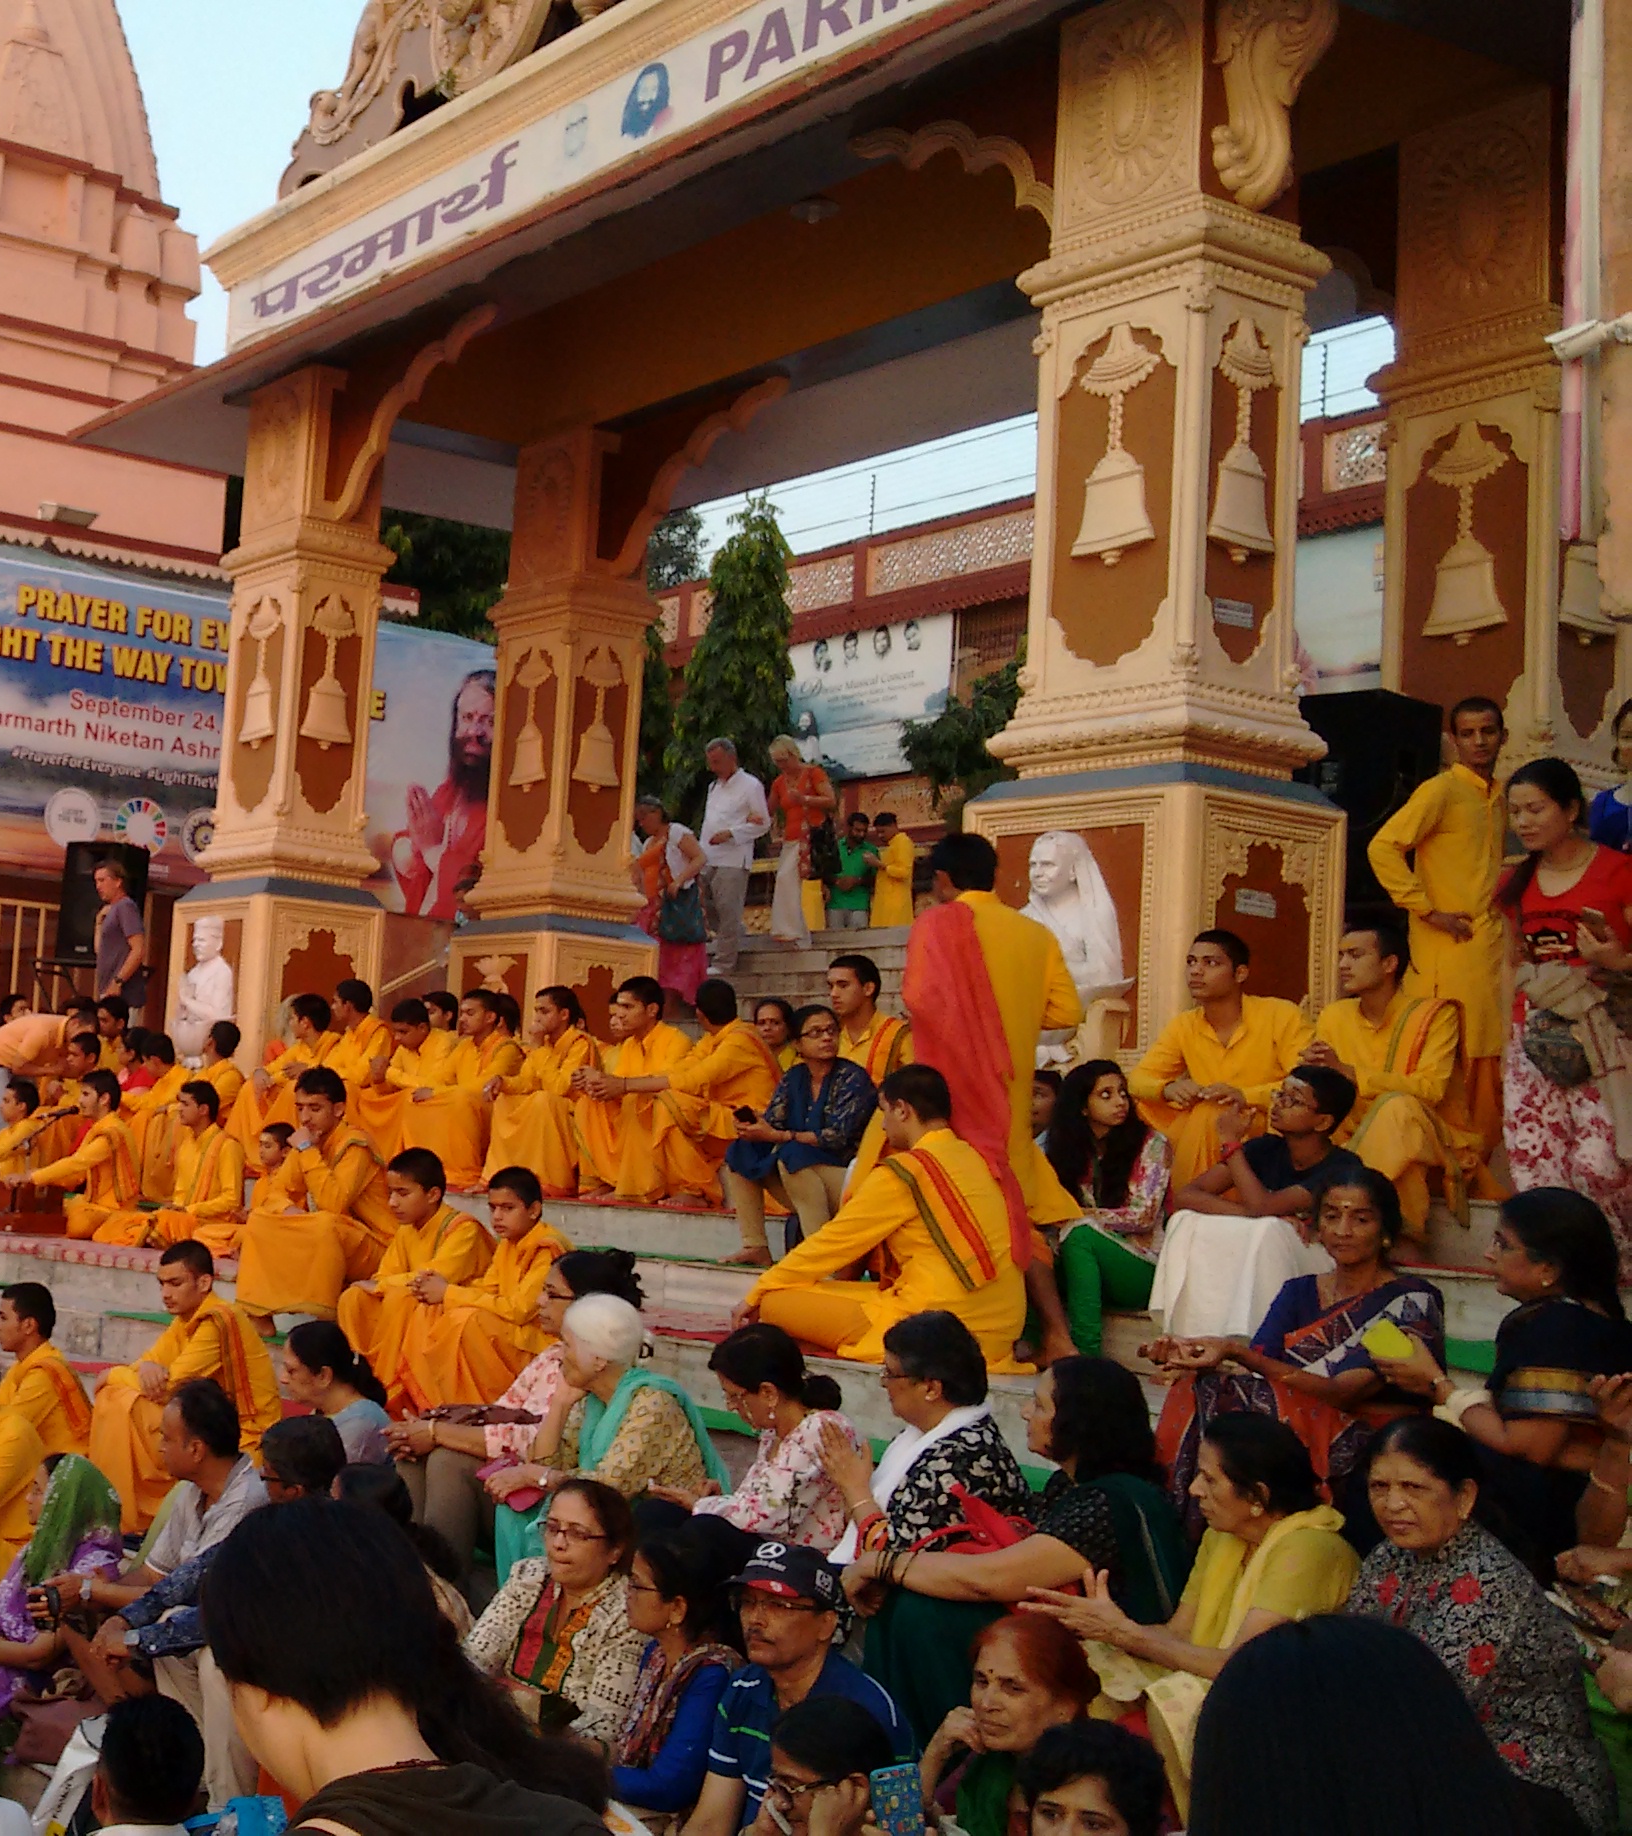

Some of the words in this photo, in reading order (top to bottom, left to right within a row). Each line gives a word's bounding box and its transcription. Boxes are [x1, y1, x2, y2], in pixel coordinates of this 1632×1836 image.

[250, 140, 520, 318] परमार्थ
[17, 584, 128, 634] PRAYER
[135, 605, 192, 646] FOR
[48, 632, 105, 674] THE
[112, 644, 172, 684] WAY
[70, 689, 185, 728] September
[84, 721, 164, 753] Niketan
[11, 746, 141, 778] #PrayerForEveryone
